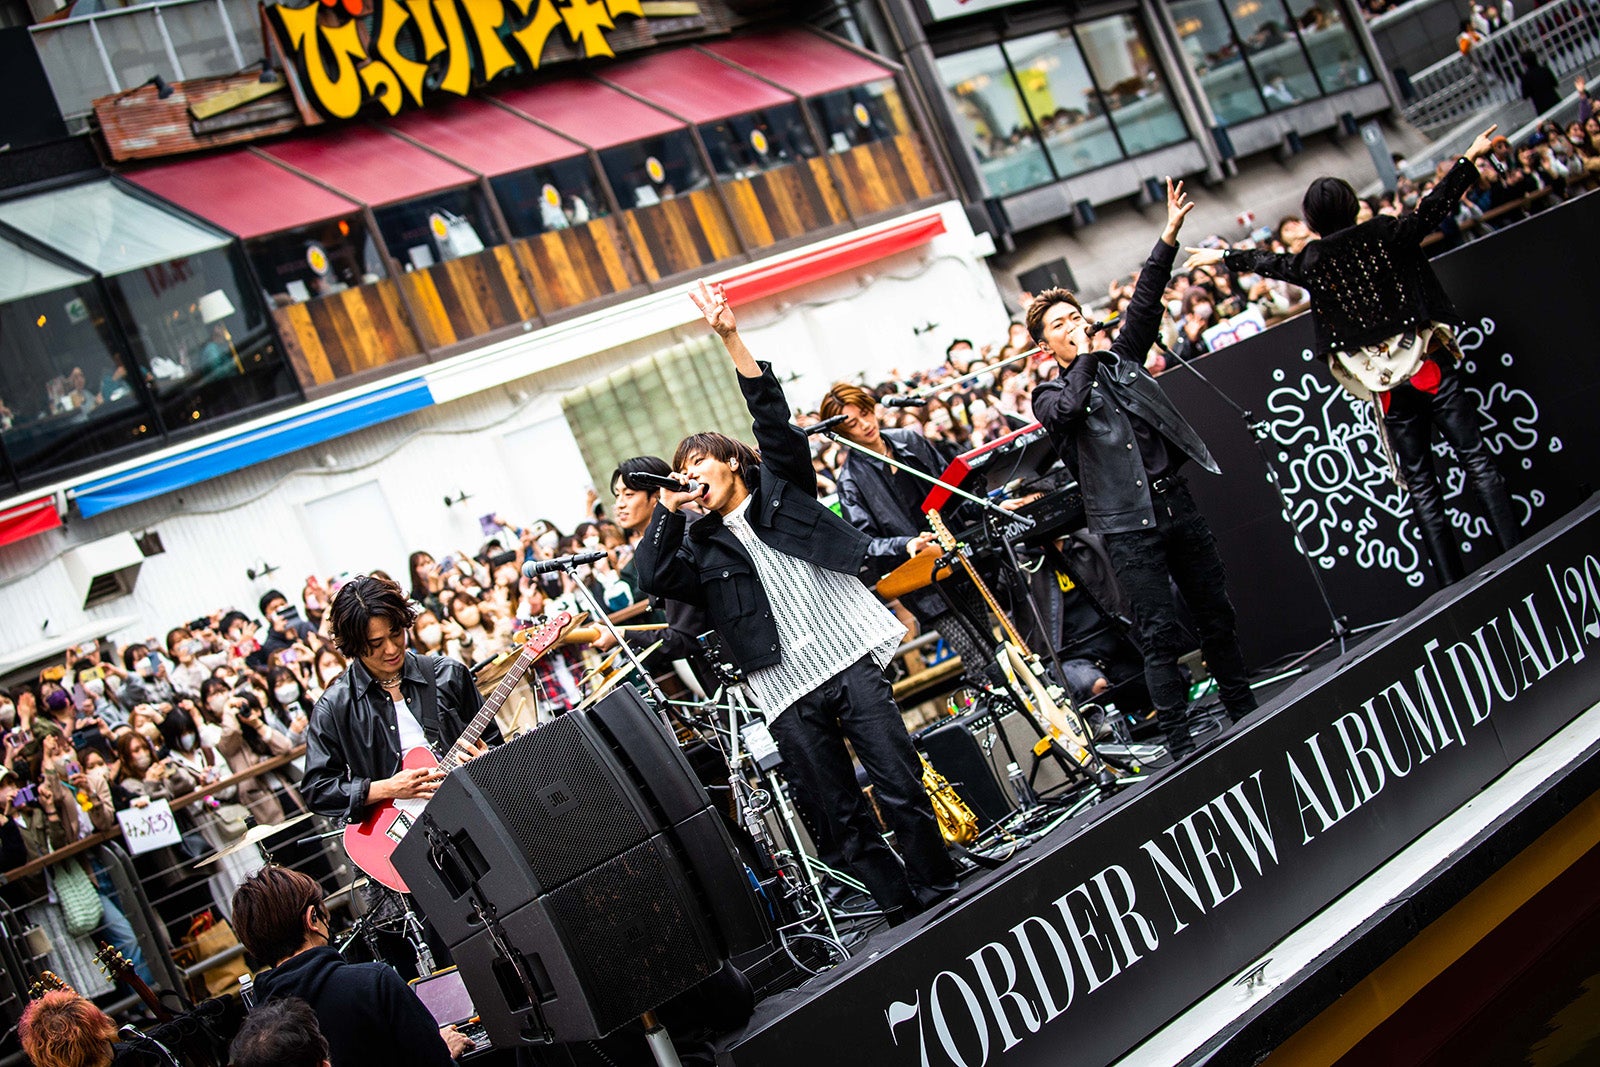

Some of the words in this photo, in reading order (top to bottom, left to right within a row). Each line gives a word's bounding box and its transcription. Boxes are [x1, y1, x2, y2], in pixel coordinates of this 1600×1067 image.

[547, 790, 570, 807] JBL
[884, 865, 1159, 1067] 7ORDER
[1139, 769, 1279, 935] NEW
